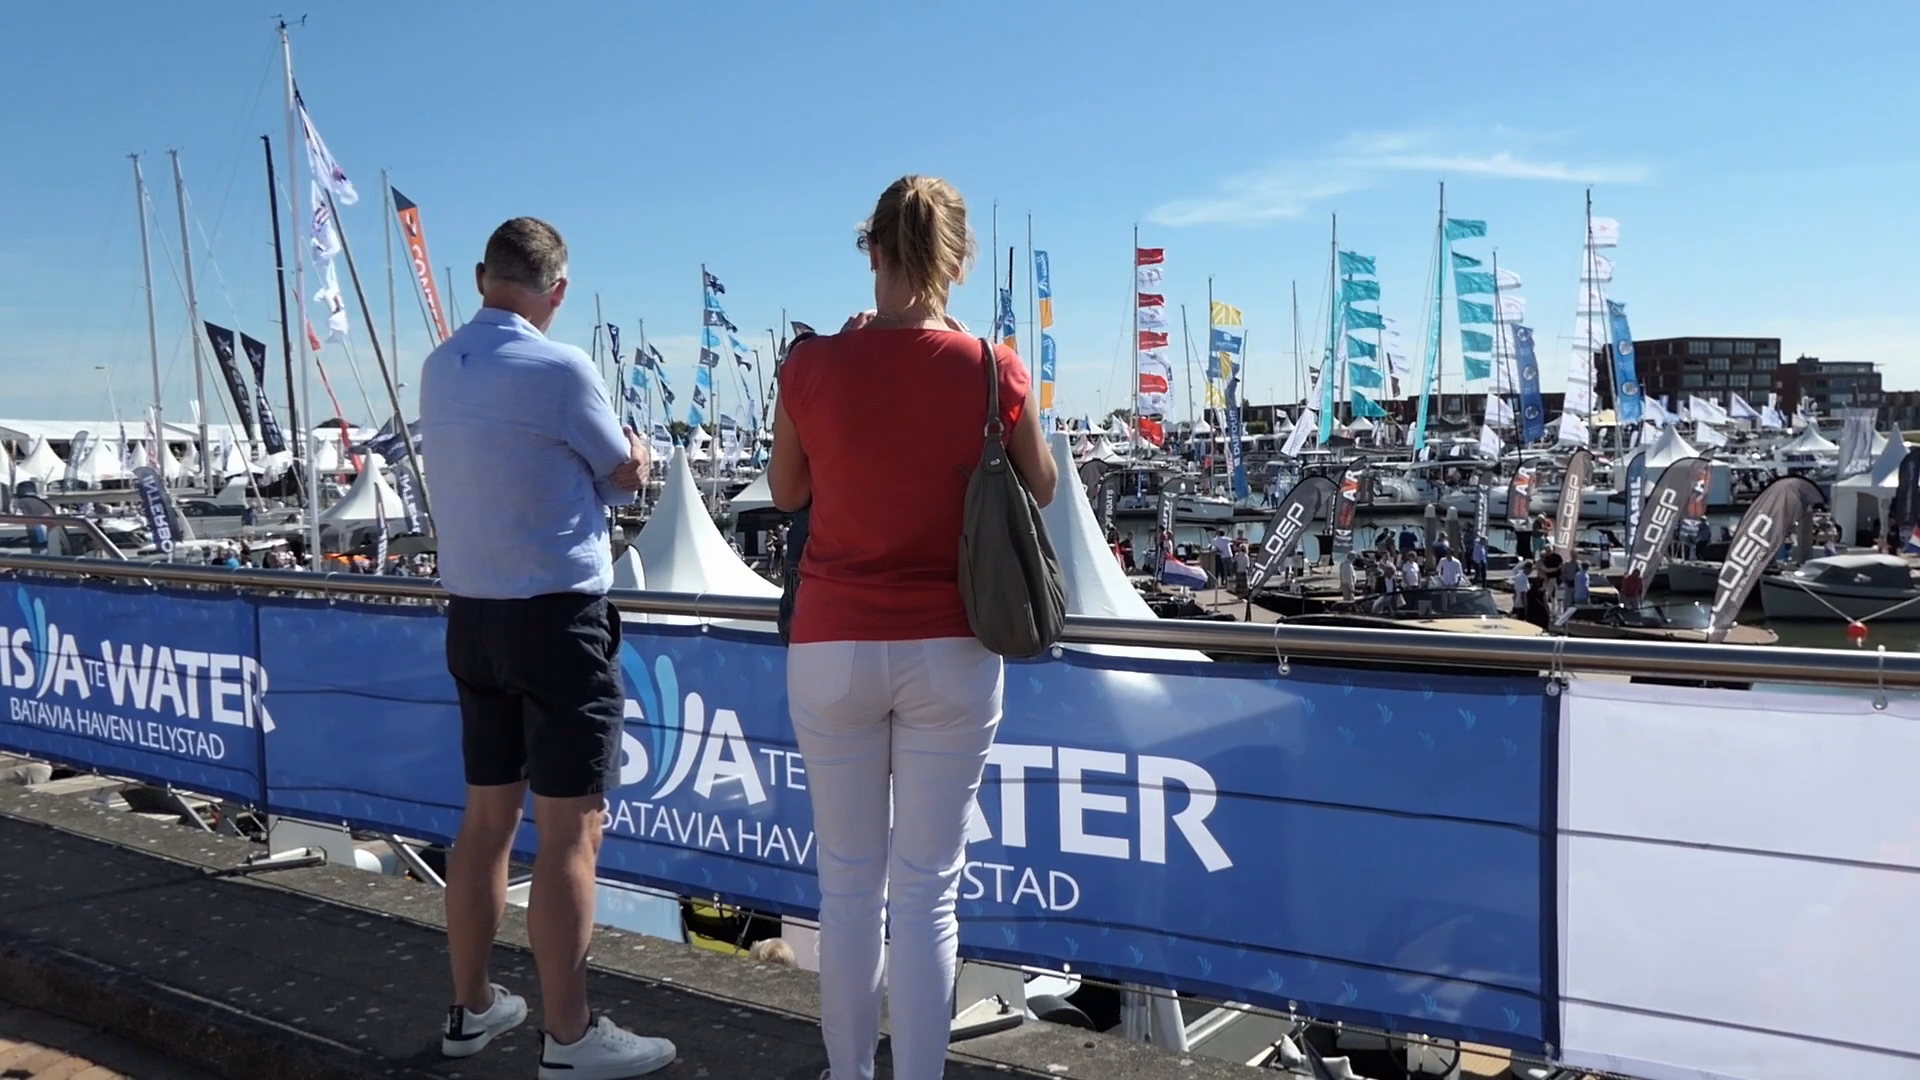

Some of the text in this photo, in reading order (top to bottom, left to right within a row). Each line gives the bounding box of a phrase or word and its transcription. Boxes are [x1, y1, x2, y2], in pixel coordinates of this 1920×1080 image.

[1105, 489, 1114, 515] BOATS
[1250, 502, 1304, 589] SLOEP
[1559, 473, 1580, 549] SLOEP
[1628, 488, 1679, 577] SLOEP
[1710, 514, 1773, 620] LOEP
[10, 696, 225, 760] BATAVIA HAVEN LELYSTAD
[85, 659, 105, 688] TE
[101, 639, 276, 734] WATER
[760, 748, 807, 790] TE
[967, 743, 1234, 873] TER
[738, 818, 819, 866] HAV
[963, 860, 1080, 911] STAD
